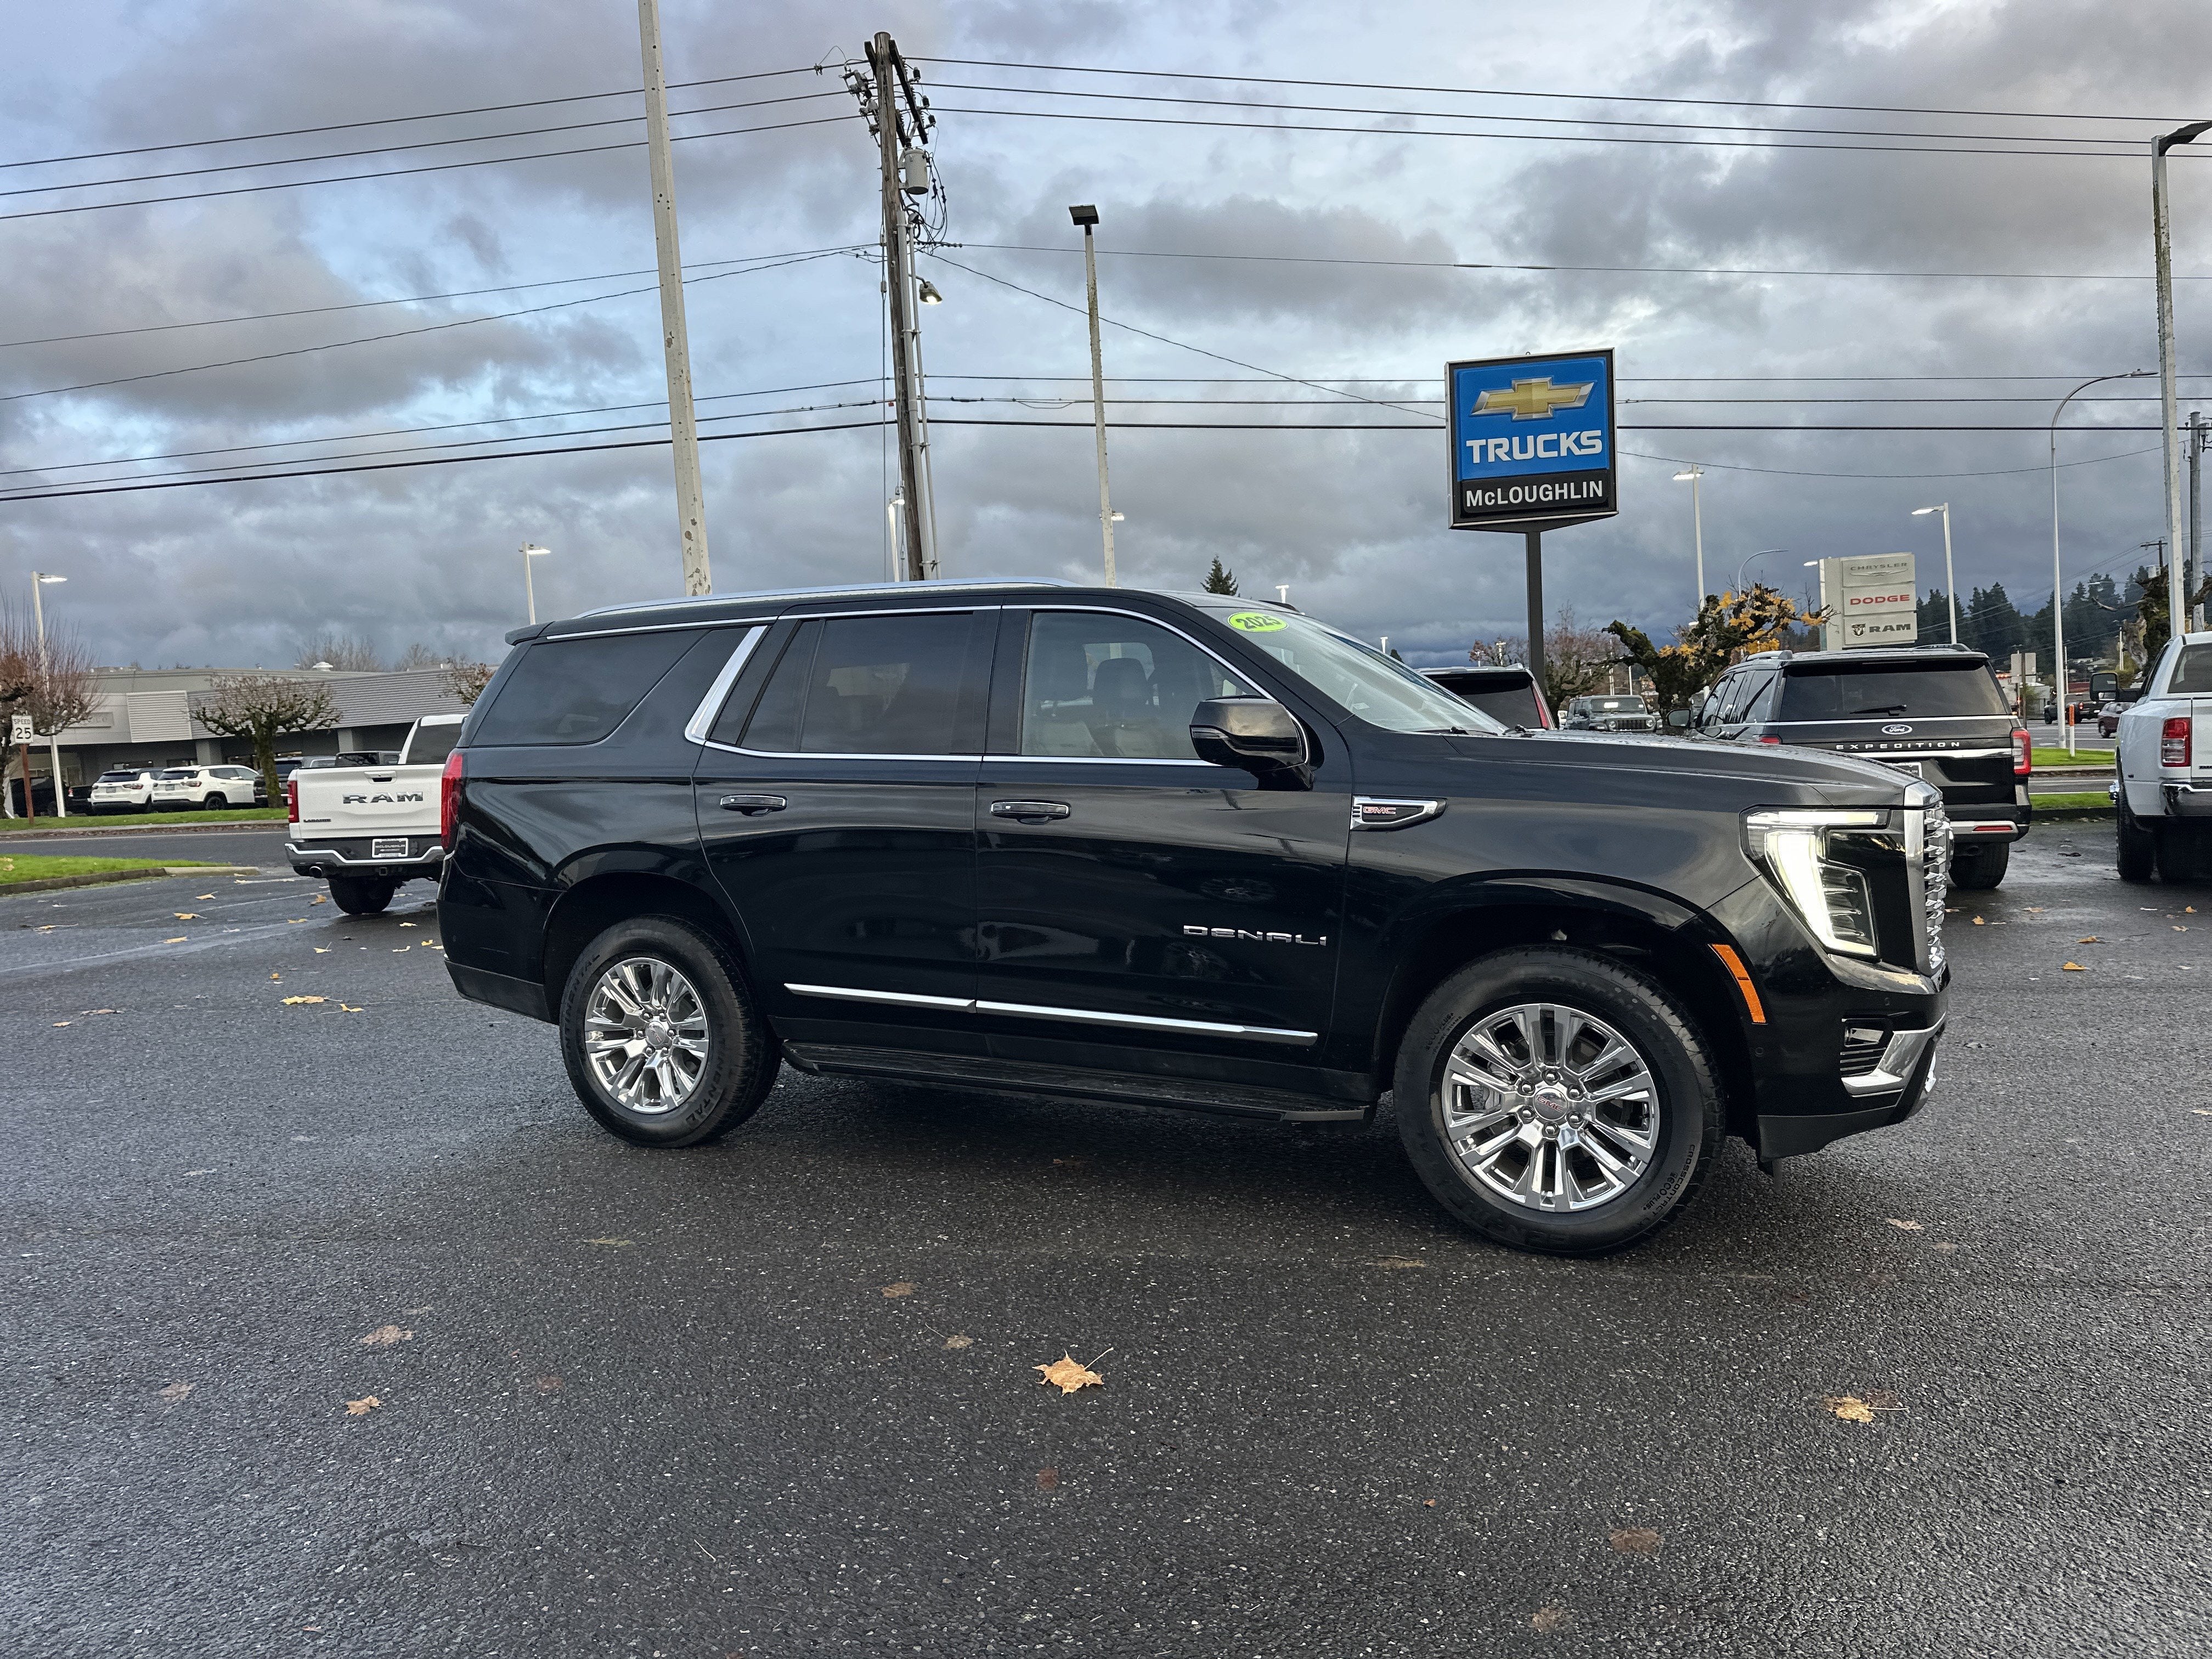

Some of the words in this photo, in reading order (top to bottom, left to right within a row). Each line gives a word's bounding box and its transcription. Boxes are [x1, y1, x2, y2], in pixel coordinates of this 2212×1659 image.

[1466, 430, 1602, 464] TRUCKS
[1466, 480, 1603, 507] McLOUGHLIN
[1850, 562, 1908, 571] CHRYSLER
[1850, 594, 1910, 606] DODGE
[1235, 616, 1282, 629] 2025
[1869, 623, 1911, 633] RAM
[15, 727, 31, 739] 25
[1836, 742, 1960, 750] EXPEDITION
[342, 791, 424, 804] RAM
[1183, 925, 1327, 946] DENALI
[1537, 1095, 1563, 1113] GMC
